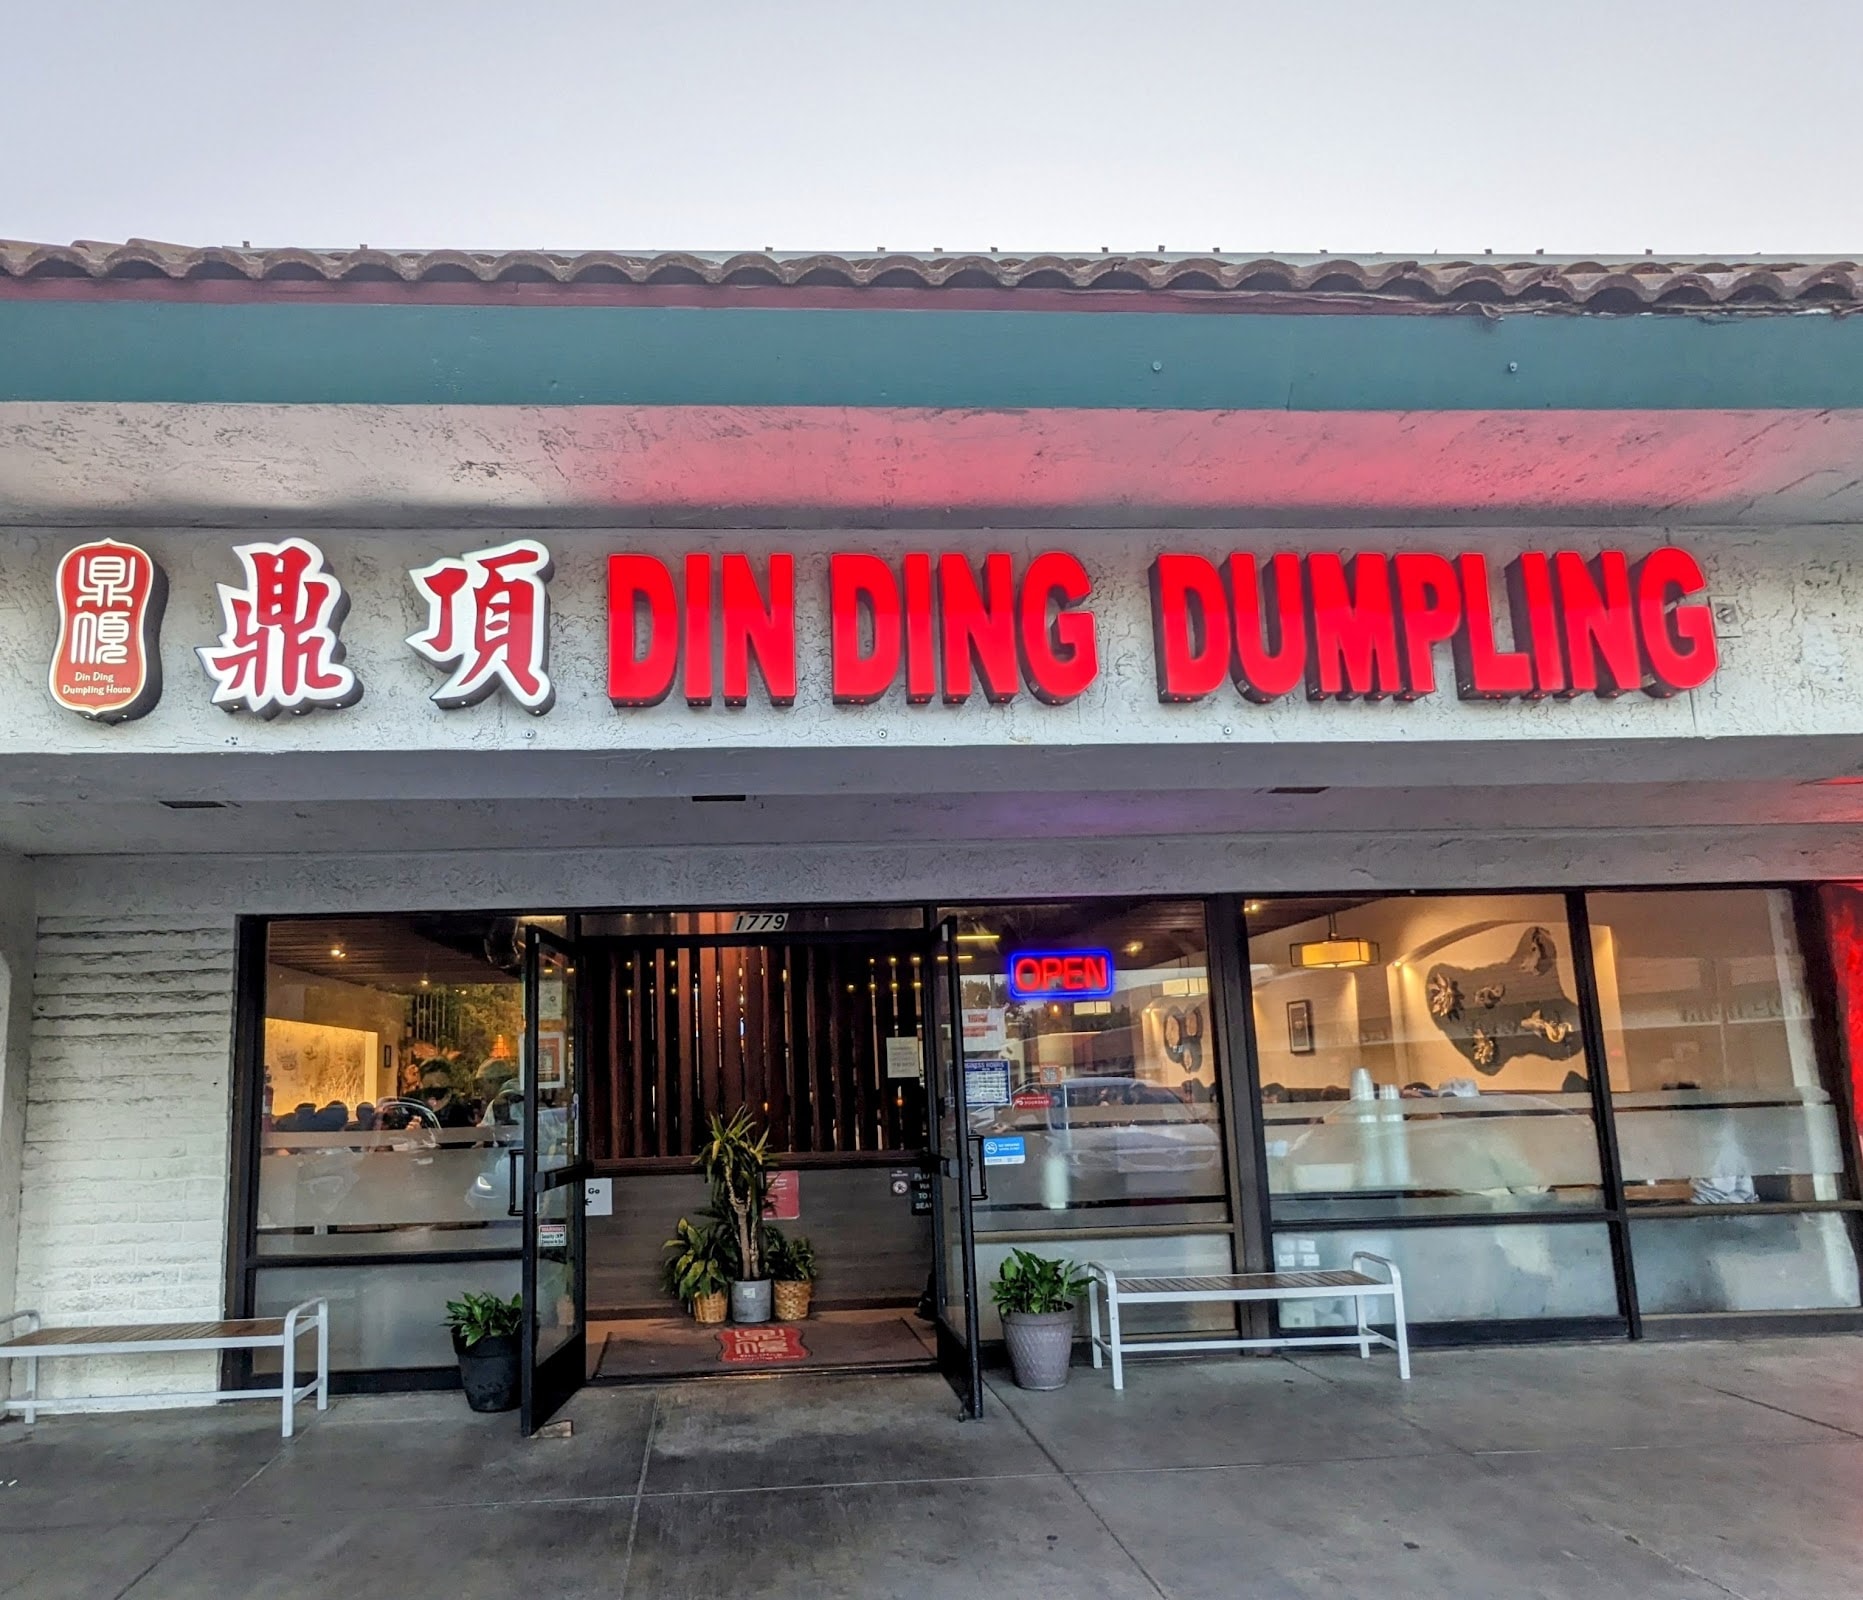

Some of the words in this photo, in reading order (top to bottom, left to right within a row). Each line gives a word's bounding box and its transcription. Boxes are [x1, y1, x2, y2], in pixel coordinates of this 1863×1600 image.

[608, 552, 797, 702] DIN
[830, 551, 1098, 702] DING
[1154, 547, 1719, 698] DUMPLING
[75, 671, 91, 682] Din
[93, 671, 114, 683] Ding
[62, 684, 104, 696] Dumpling
[735, 914, 785, 931] 1779
[1015, 957, 1107, 991] OPEN
